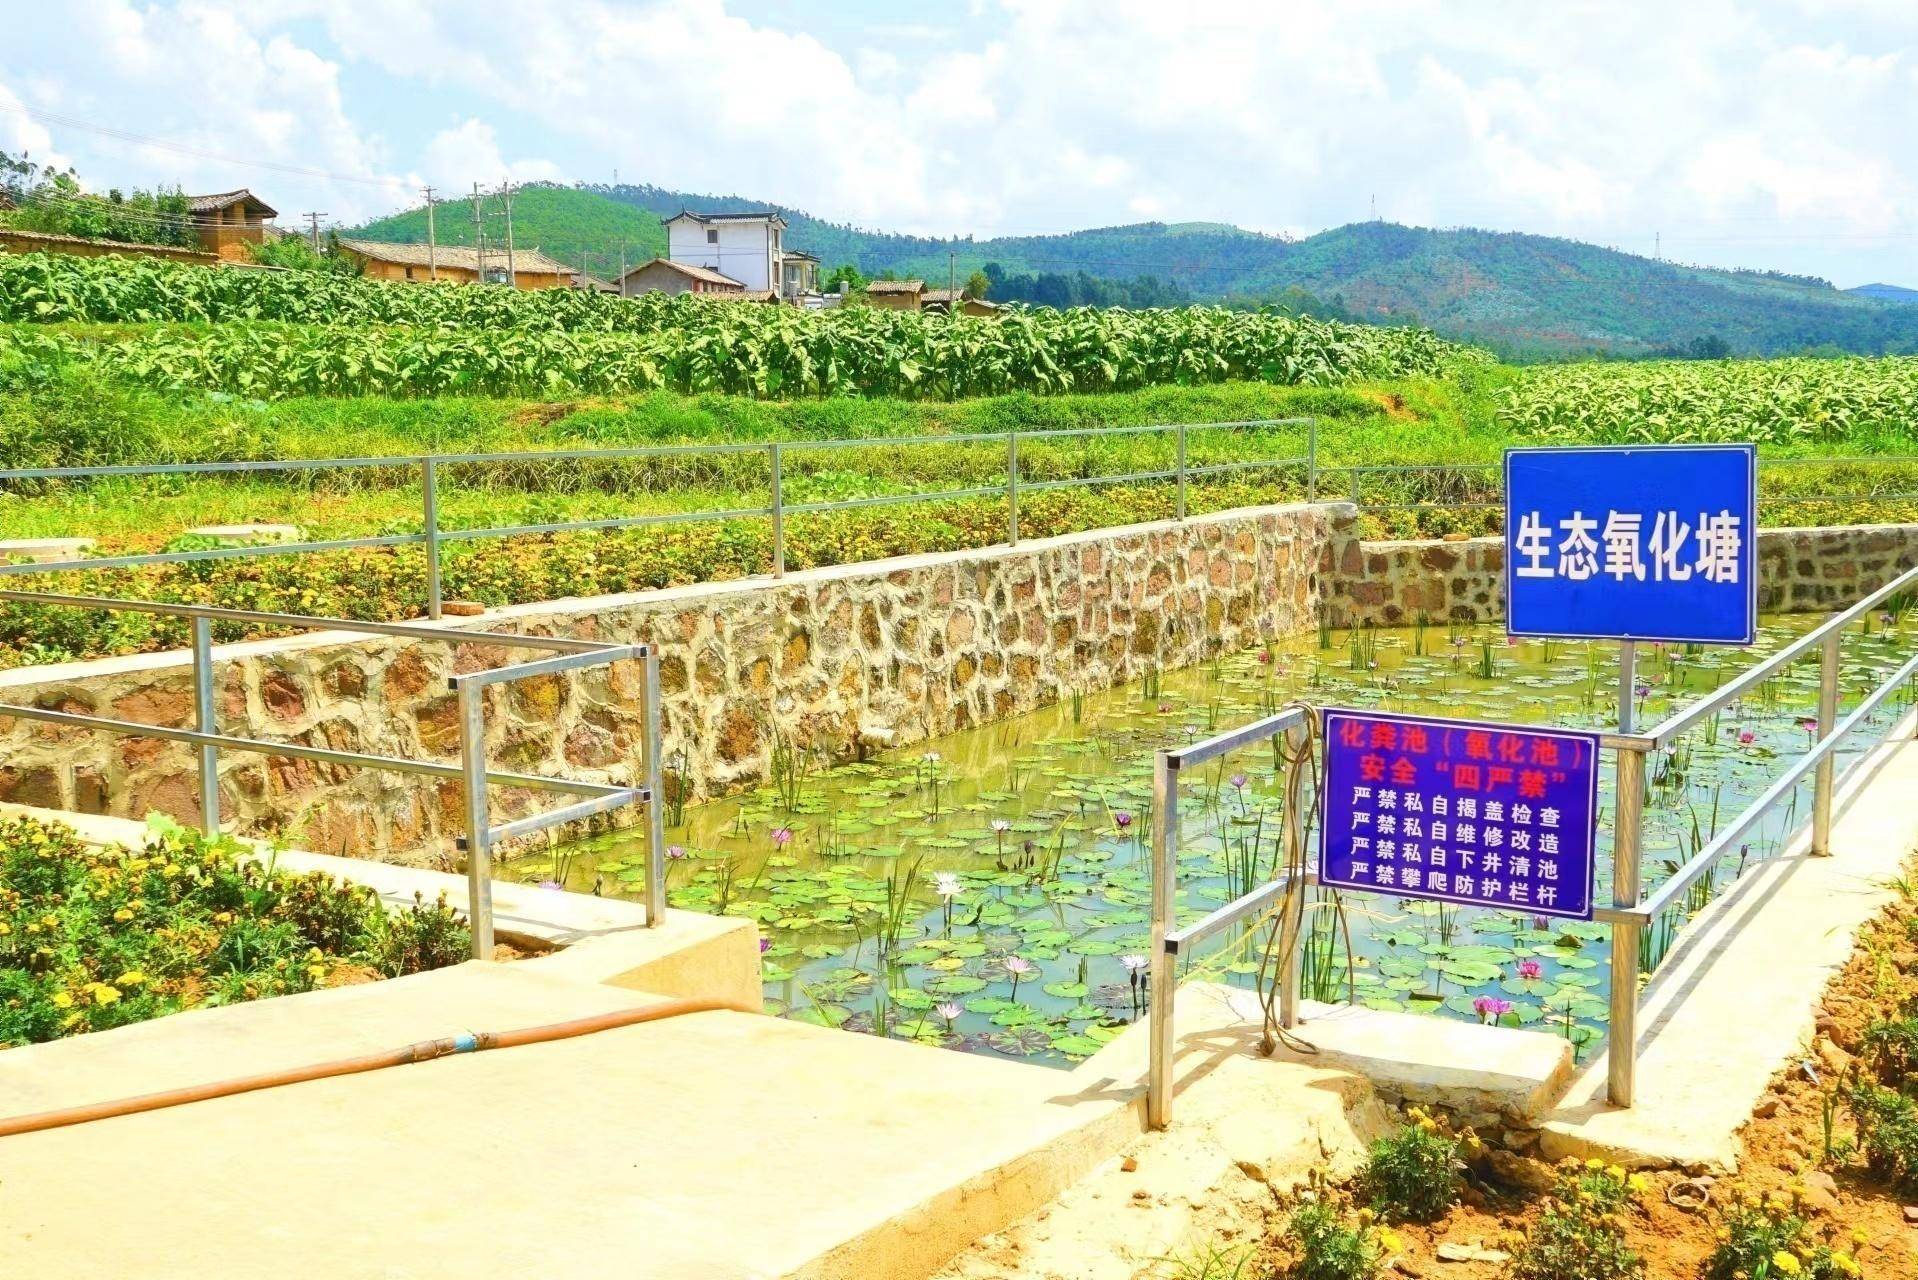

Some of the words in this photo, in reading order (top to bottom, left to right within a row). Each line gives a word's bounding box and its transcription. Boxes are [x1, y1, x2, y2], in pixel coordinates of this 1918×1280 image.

[1516, 509, 1741, 583] 生态氧化塘
[1352, 786, 1560, 828] 严禁私自揭盖检查
[1351, 811, 1560, 855] 严禁私自维修改造
[1350, 836, 1559, 880] 严禁私自下井清池
[1350, 861, 1558, 906] 严禁攀爬防护栏杆
